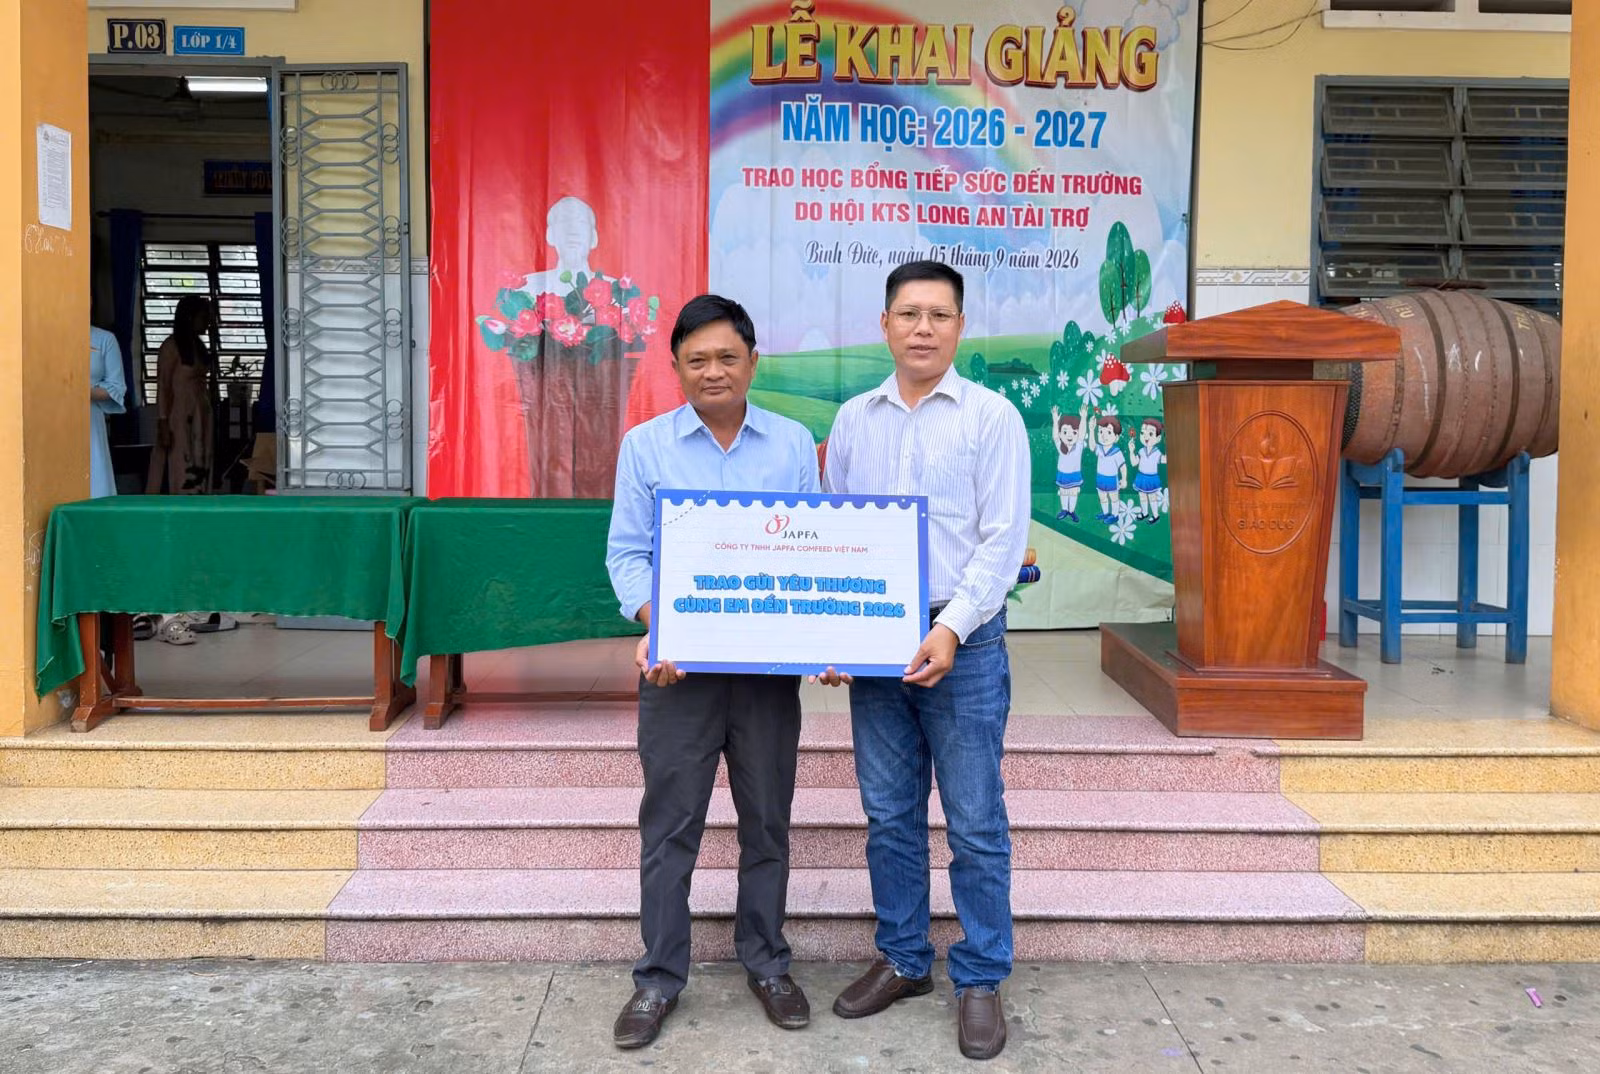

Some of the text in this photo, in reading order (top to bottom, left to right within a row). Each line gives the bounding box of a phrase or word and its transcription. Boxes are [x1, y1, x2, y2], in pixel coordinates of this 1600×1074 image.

[112, 24, 161, 49] P.03
[181, 32, 237, 50] LỚP 1/4
[749, 0, 1159, 90] LỄ KHAI GIẢNG
[782, 95, 851, 142] NĂM
[860, 104, 927, 152] HỌC:
[934, 107, 1005, 147] 2026
[1034, 109, 1107, 148] 2027
[742, 161, 1142, 195] TRAO HỌC BỔNG TIẾP SỨC ĐẾN TRƯỜNG
[795, 198, 1090, 231] DO HỘI KTS LONG AN TÀI TRỢ
[805, 240, 842, 264] Bình
[847, 240, 883, 268] Đức,
[930, 245, 946, 264] 05
[950, 244, 991, 272] tháng
[996, 248, 1005, 269] 9
[1009, 250, 1040, 268] năm
[1045, 248, 1079, 269] 2026
[782, 530, 819, 539] JAPFA
[715, 541, 738, 550] CÔNG
[773, 544, 795, 552] JAPFA
[798, 545, 832, 553] COMFEED
[834, 544, 849, 554] VIỆT
[694, 572, 886, 594] TRAO GỬI YÊU THƯƠNG
[673, 593, 905, 618] CÙNG EM ĐẾN TRƯỜNG 2026
